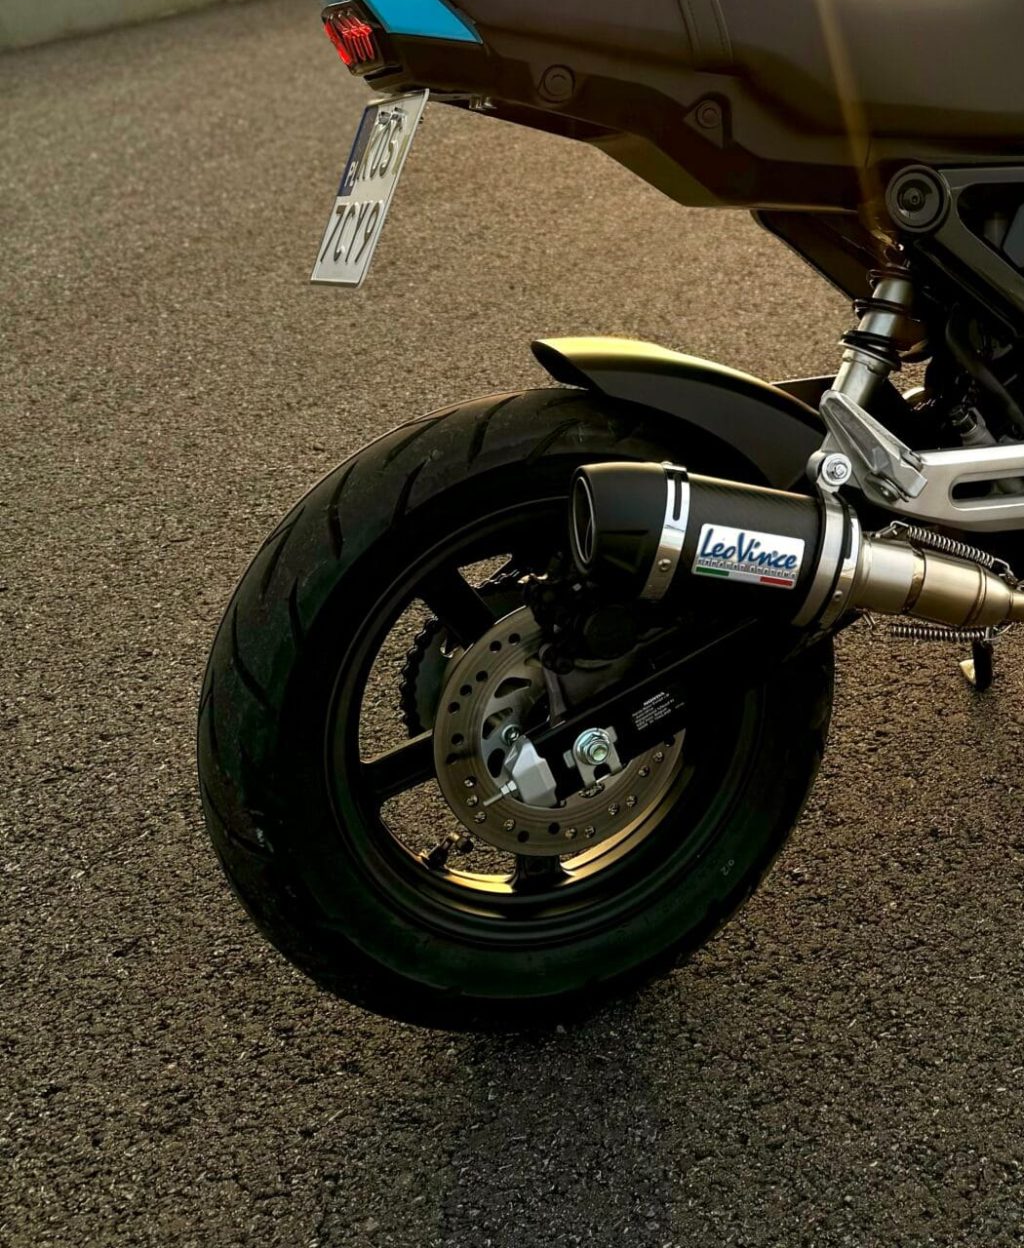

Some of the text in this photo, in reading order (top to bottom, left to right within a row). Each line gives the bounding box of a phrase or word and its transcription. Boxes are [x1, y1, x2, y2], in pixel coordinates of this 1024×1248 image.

[344, 160, 359, 189] PL
[320, 202, 381, 263] 7CY9
[700, 528, 798, 570] LeoVince
